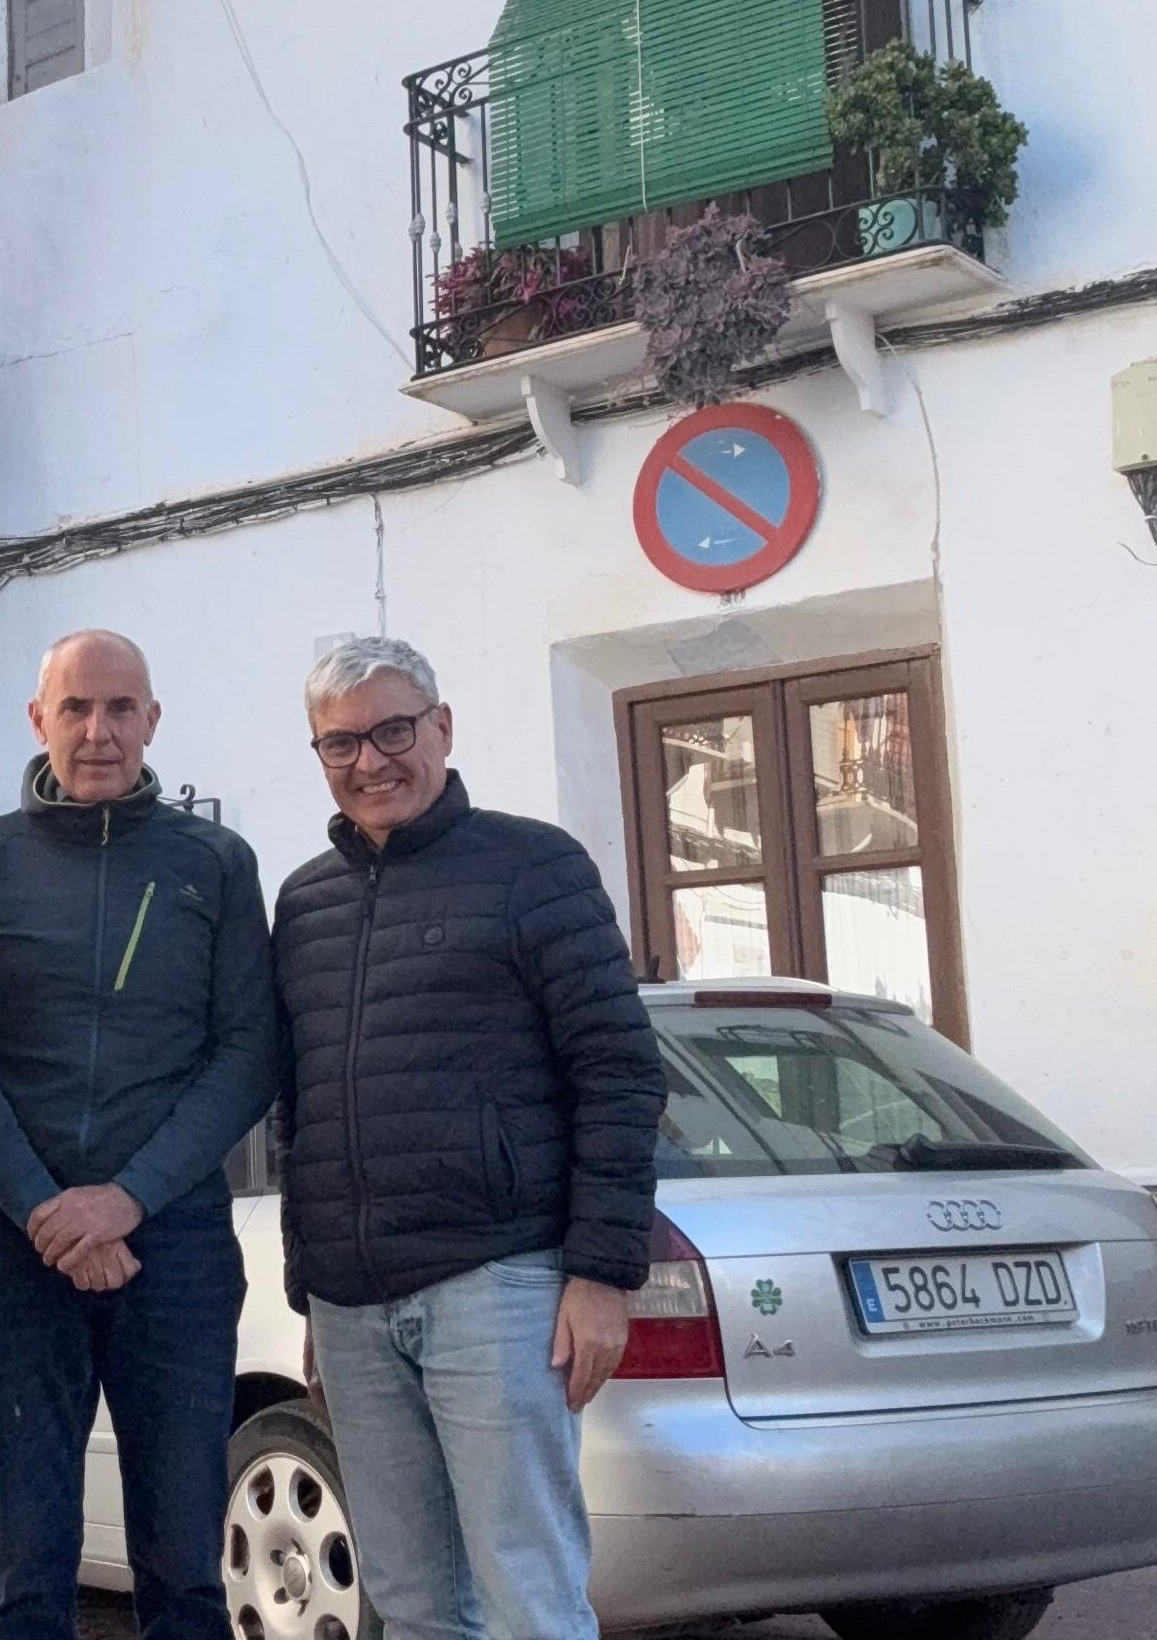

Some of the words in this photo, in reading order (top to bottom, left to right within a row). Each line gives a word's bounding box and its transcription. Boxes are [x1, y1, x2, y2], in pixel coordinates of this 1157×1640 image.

[881, 1263, 981, 1313] 5864
[992, 1260, 1062, 1307] DZD
[866, 1298, 878, 1312] E
